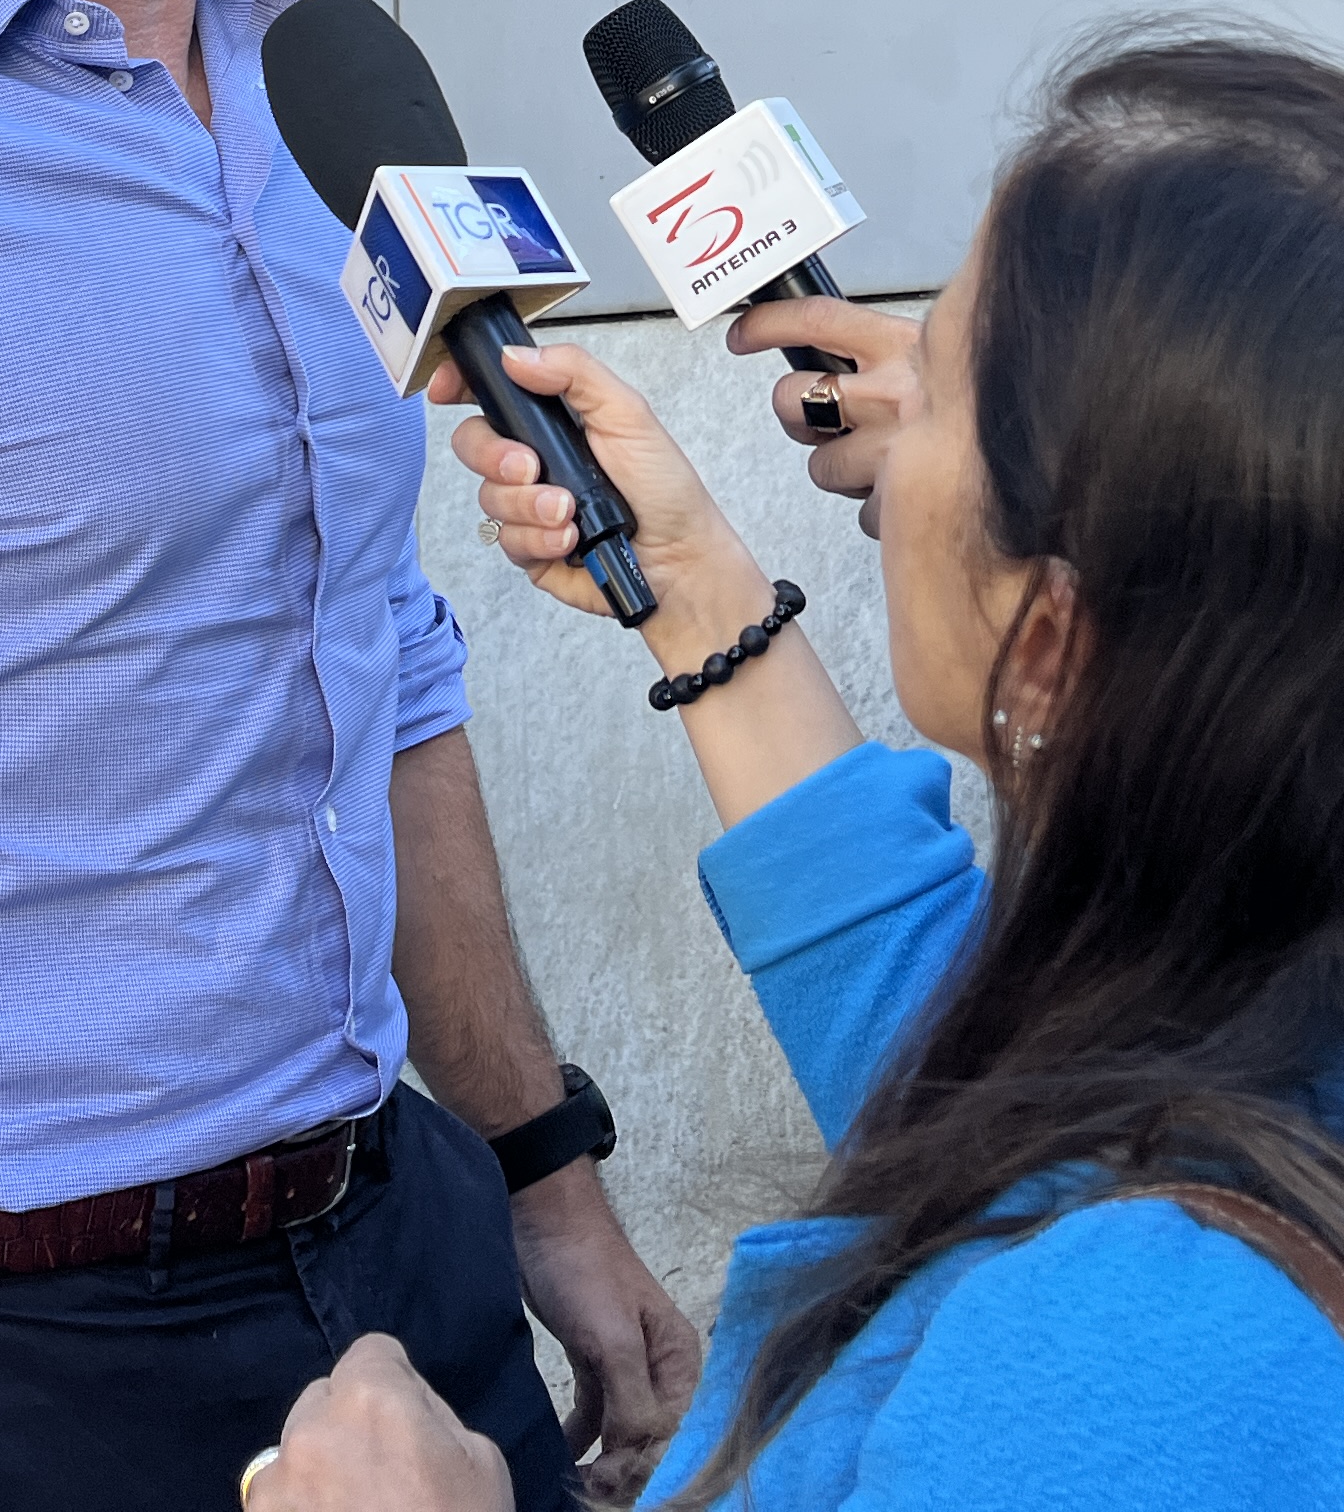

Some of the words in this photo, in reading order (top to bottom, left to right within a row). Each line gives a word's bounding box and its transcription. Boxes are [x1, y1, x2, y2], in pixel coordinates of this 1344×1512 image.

[432, 202, 523, 240] TGR
[691, 231, 781, 295] ANTENNA
[781, 219, 798, 236] 3
[362, 254, 401, 334] TGR
